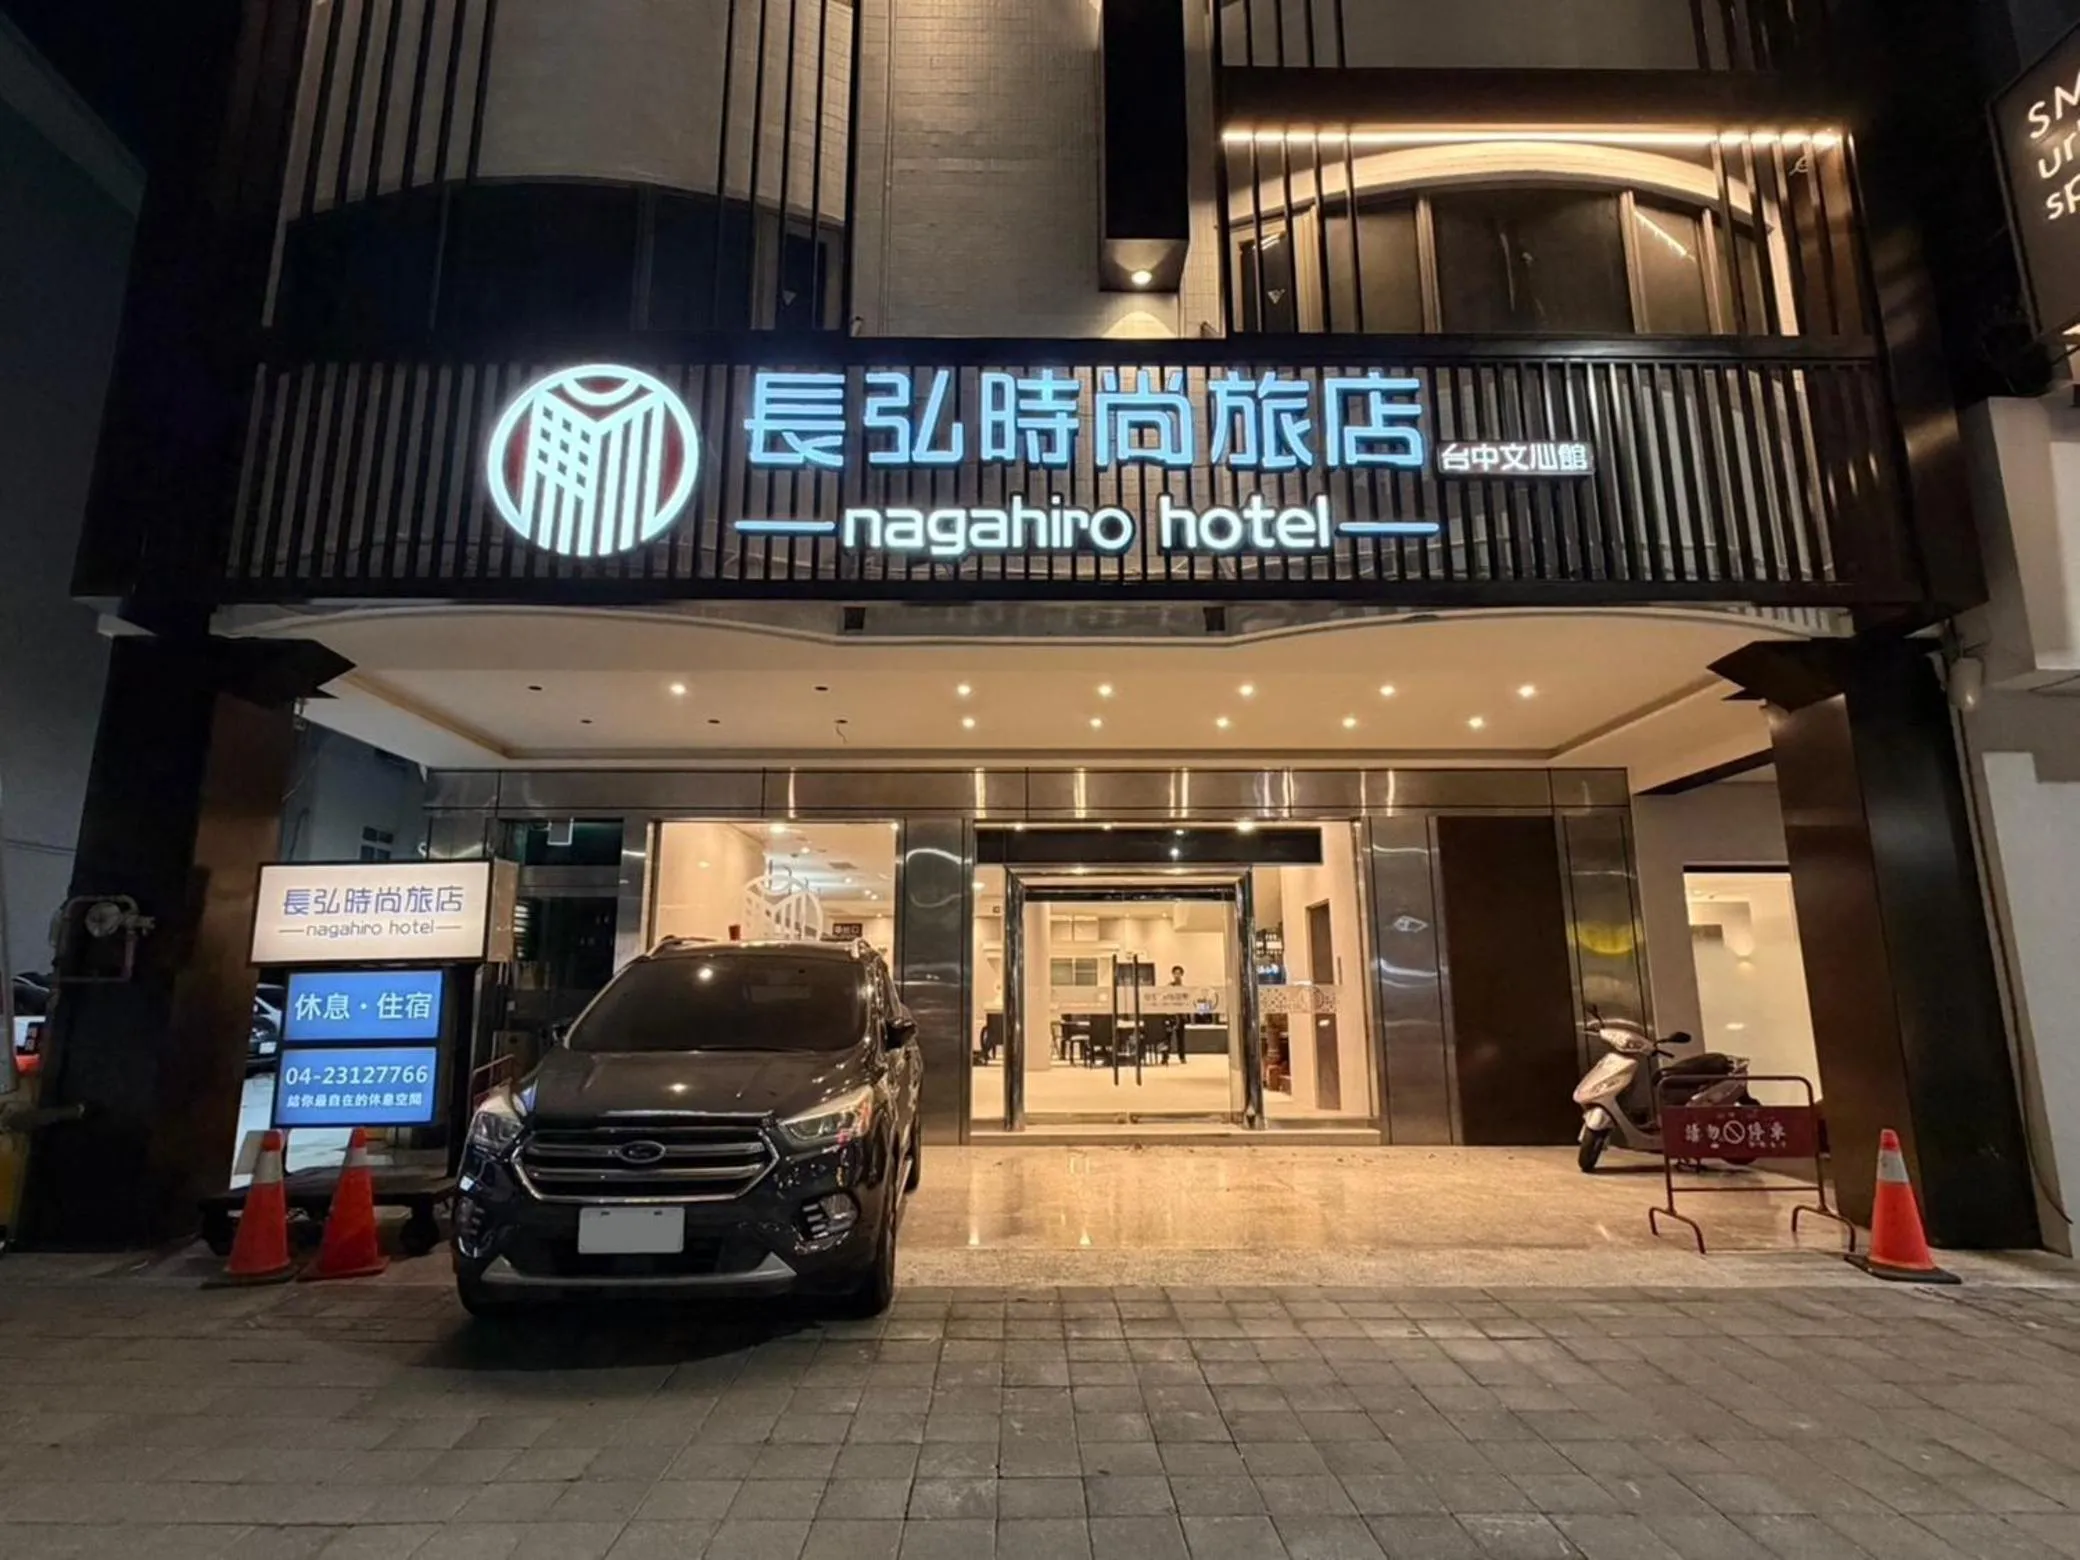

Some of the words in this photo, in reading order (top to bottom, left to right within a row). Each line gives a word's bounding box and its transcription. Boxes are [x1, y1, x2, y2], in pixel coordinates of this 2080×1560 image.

[2038, 119, 2080, 179] ur
[743, 366, 1424, 470] 長弘時尚旅店
[1441, 442, 1588, 472] 台中文心館
[844, 495, 1132, 556] nagahiro
[1161, 495, 1330, 550] hotel
[283, 886, 463, 915] 長弘時尚旅店
[306, 921, 383, 939] nagahiro
[389, 920, 435, 935] hotel
[285, 1065, 428, 1085] 04-23127766
